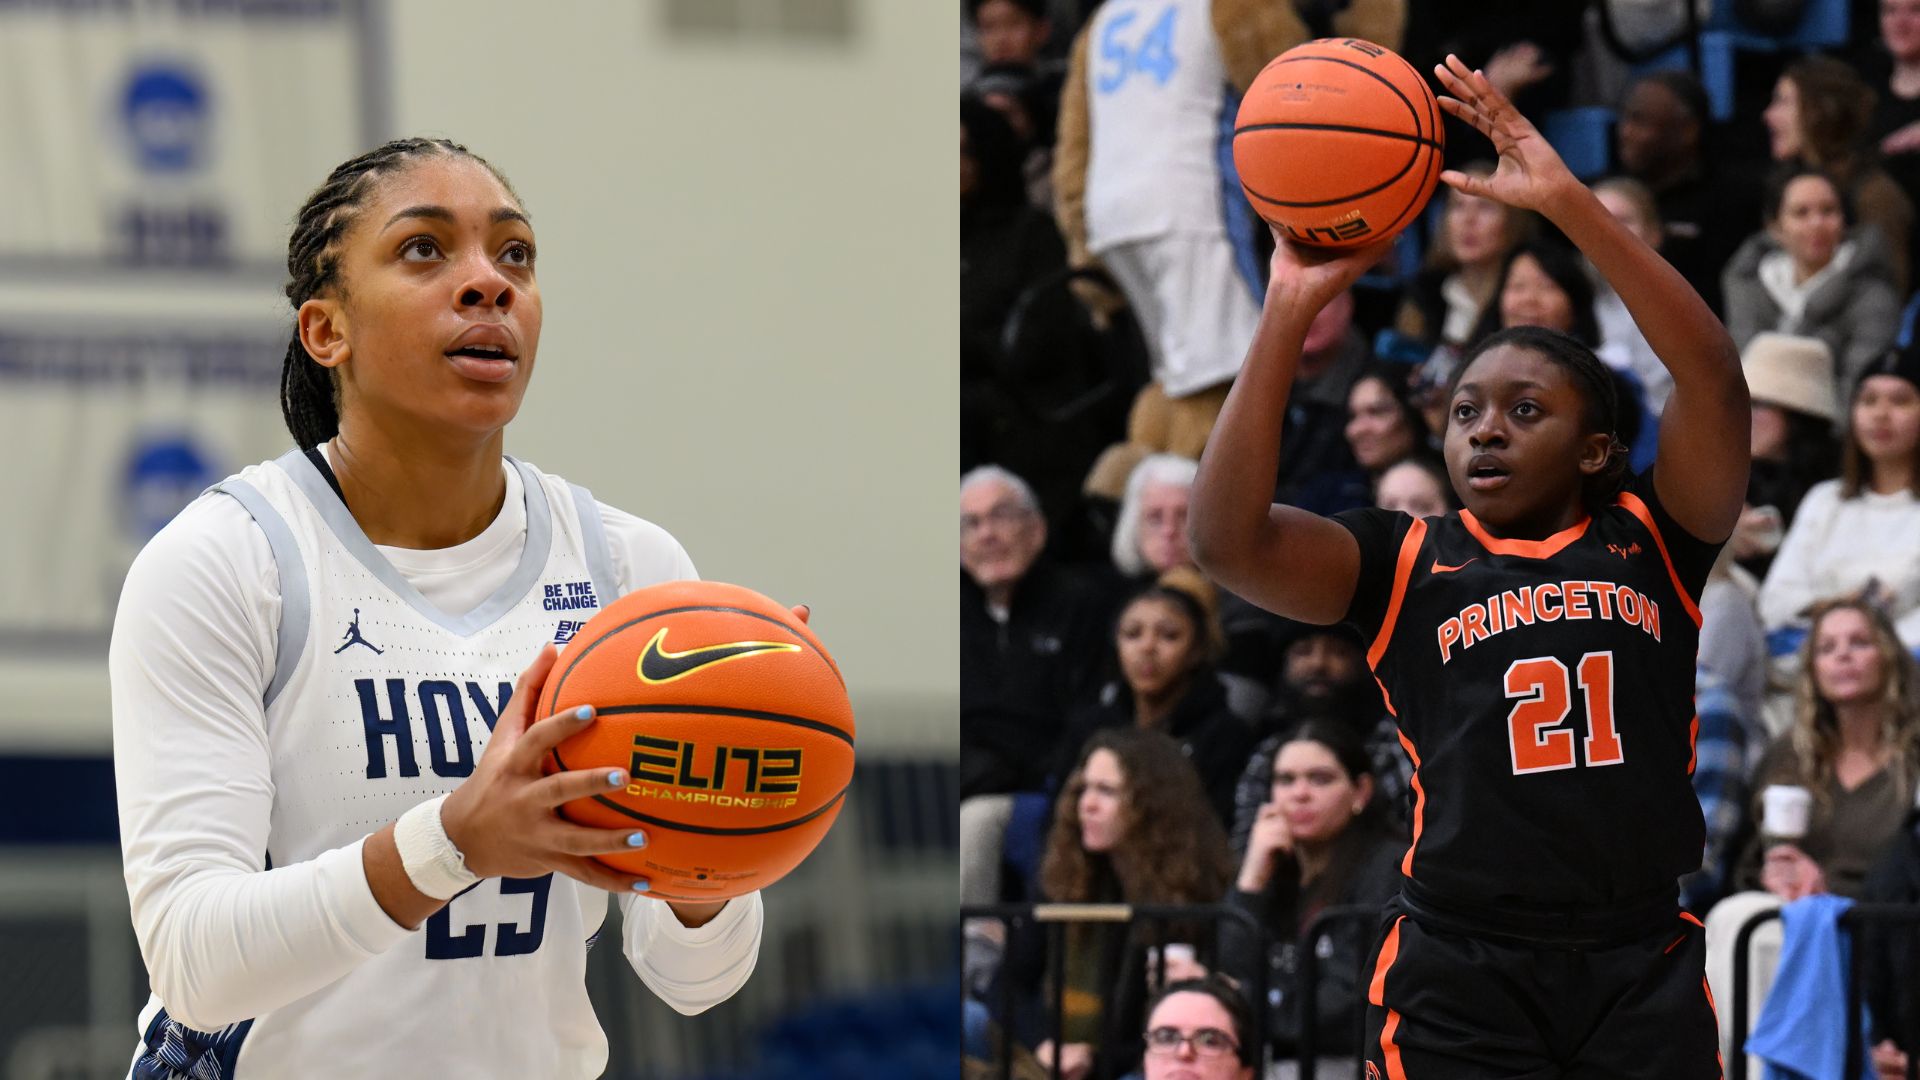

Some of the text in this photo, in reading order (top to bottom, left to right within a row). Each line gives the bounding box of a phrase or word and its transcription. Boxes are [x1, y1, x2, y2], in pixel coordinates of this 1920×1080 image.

[1098, 5, 1177, 94] 54
[543, 595, 598, 611] CHANGE
[544, 582, 592, 597] BE THE
[1438, 581, 1660, 664] PRINCETON
[354, 678, 514, 780] HOY
[1504, 651, 1624, 775] 21
[626, 784, 798, 808] CHAMPIONSHIP
[629, 734, 803, 794] ELITE
